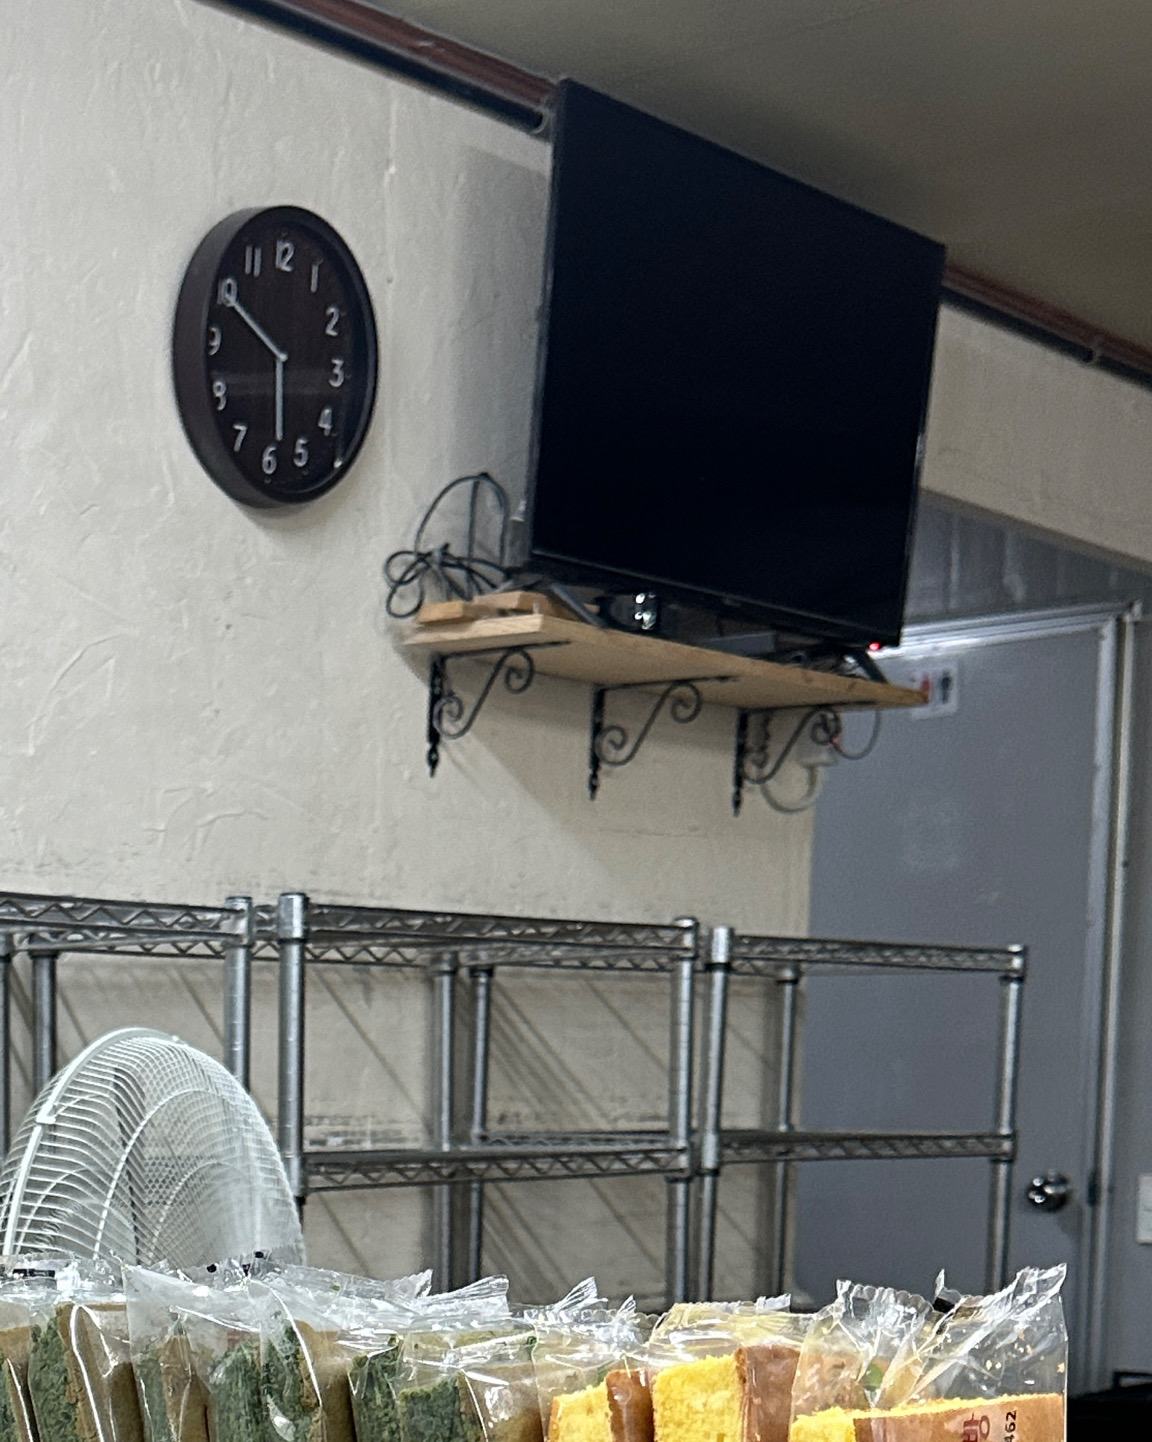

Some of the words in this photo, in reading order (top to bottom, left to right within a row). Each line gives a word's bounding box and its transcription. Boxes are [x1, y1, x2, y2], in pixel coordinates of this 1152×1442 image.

[245, 246, 262, 277] 11
[275, 240, 295, 272] 12
[310, 264, 319, 293] 1
[325, 306, 341, 336] 2
[207, 327, 222, 356] 9
[328, 358, 345, 388] 3
[212, 378, 228, 411] 8
[317, 406, 333, 436] 4
[232, 423, 247, 452] 7
[293, 437, 309, 467] 5
[261, 443, 277, 475] 6
